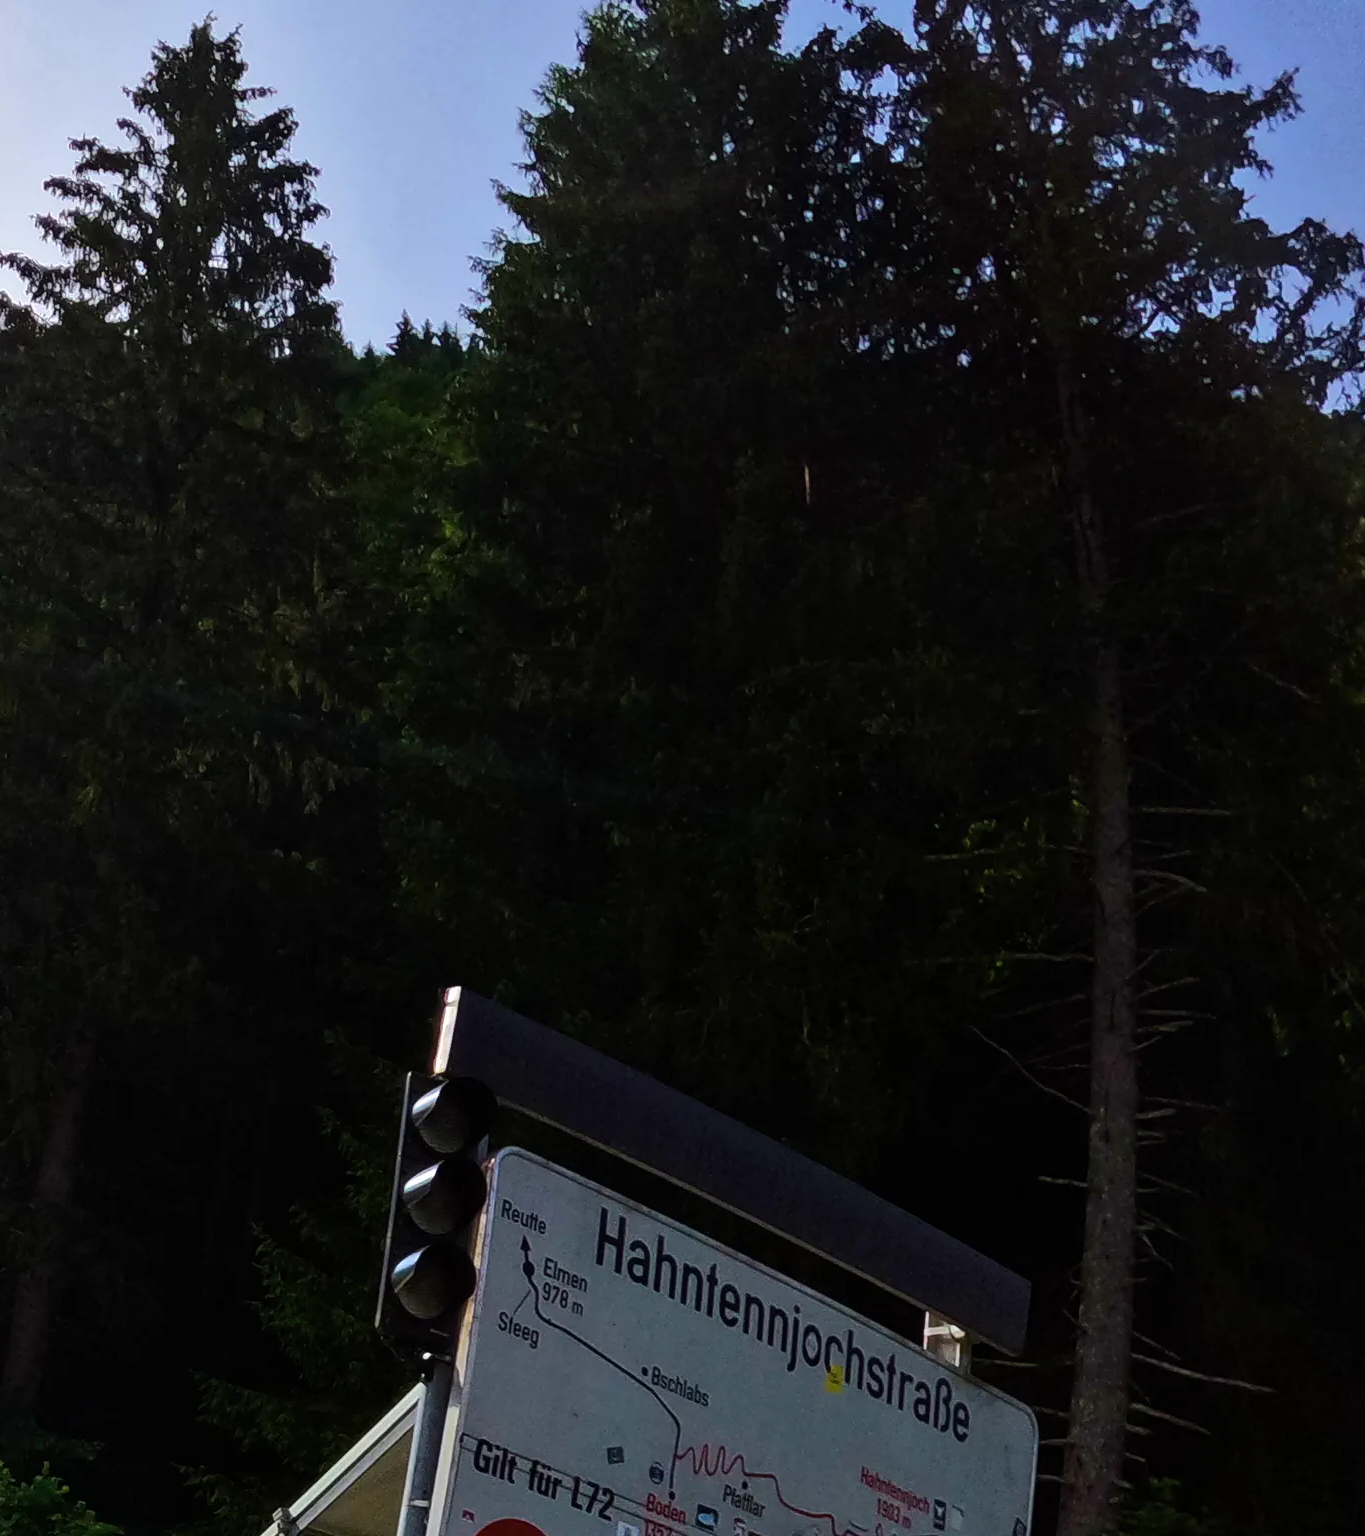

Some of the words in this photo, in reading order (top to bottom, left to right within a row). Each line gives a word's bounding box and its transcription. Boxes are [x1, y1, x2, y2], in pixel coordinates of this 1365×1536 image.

[501, 1199, 547, 1235] Reutte
[543, 1257, 588, 1293] Elmen
[542, 1282, 569, 1309] 978
[572, 1300, 584, 1317] m
[497, 1311, 540, 1349] Steeg
[595, 1207, 970, 1443] Hahntennjochstraße
[651, 1366, 709, 1407] Bschlabs
[472, 1438, 518, 1484] Gilt
[527, 1459, 563, 1500] für
[570, 1475, 615, 1521] L72
[646, 1493, 686, 1525] Boden
